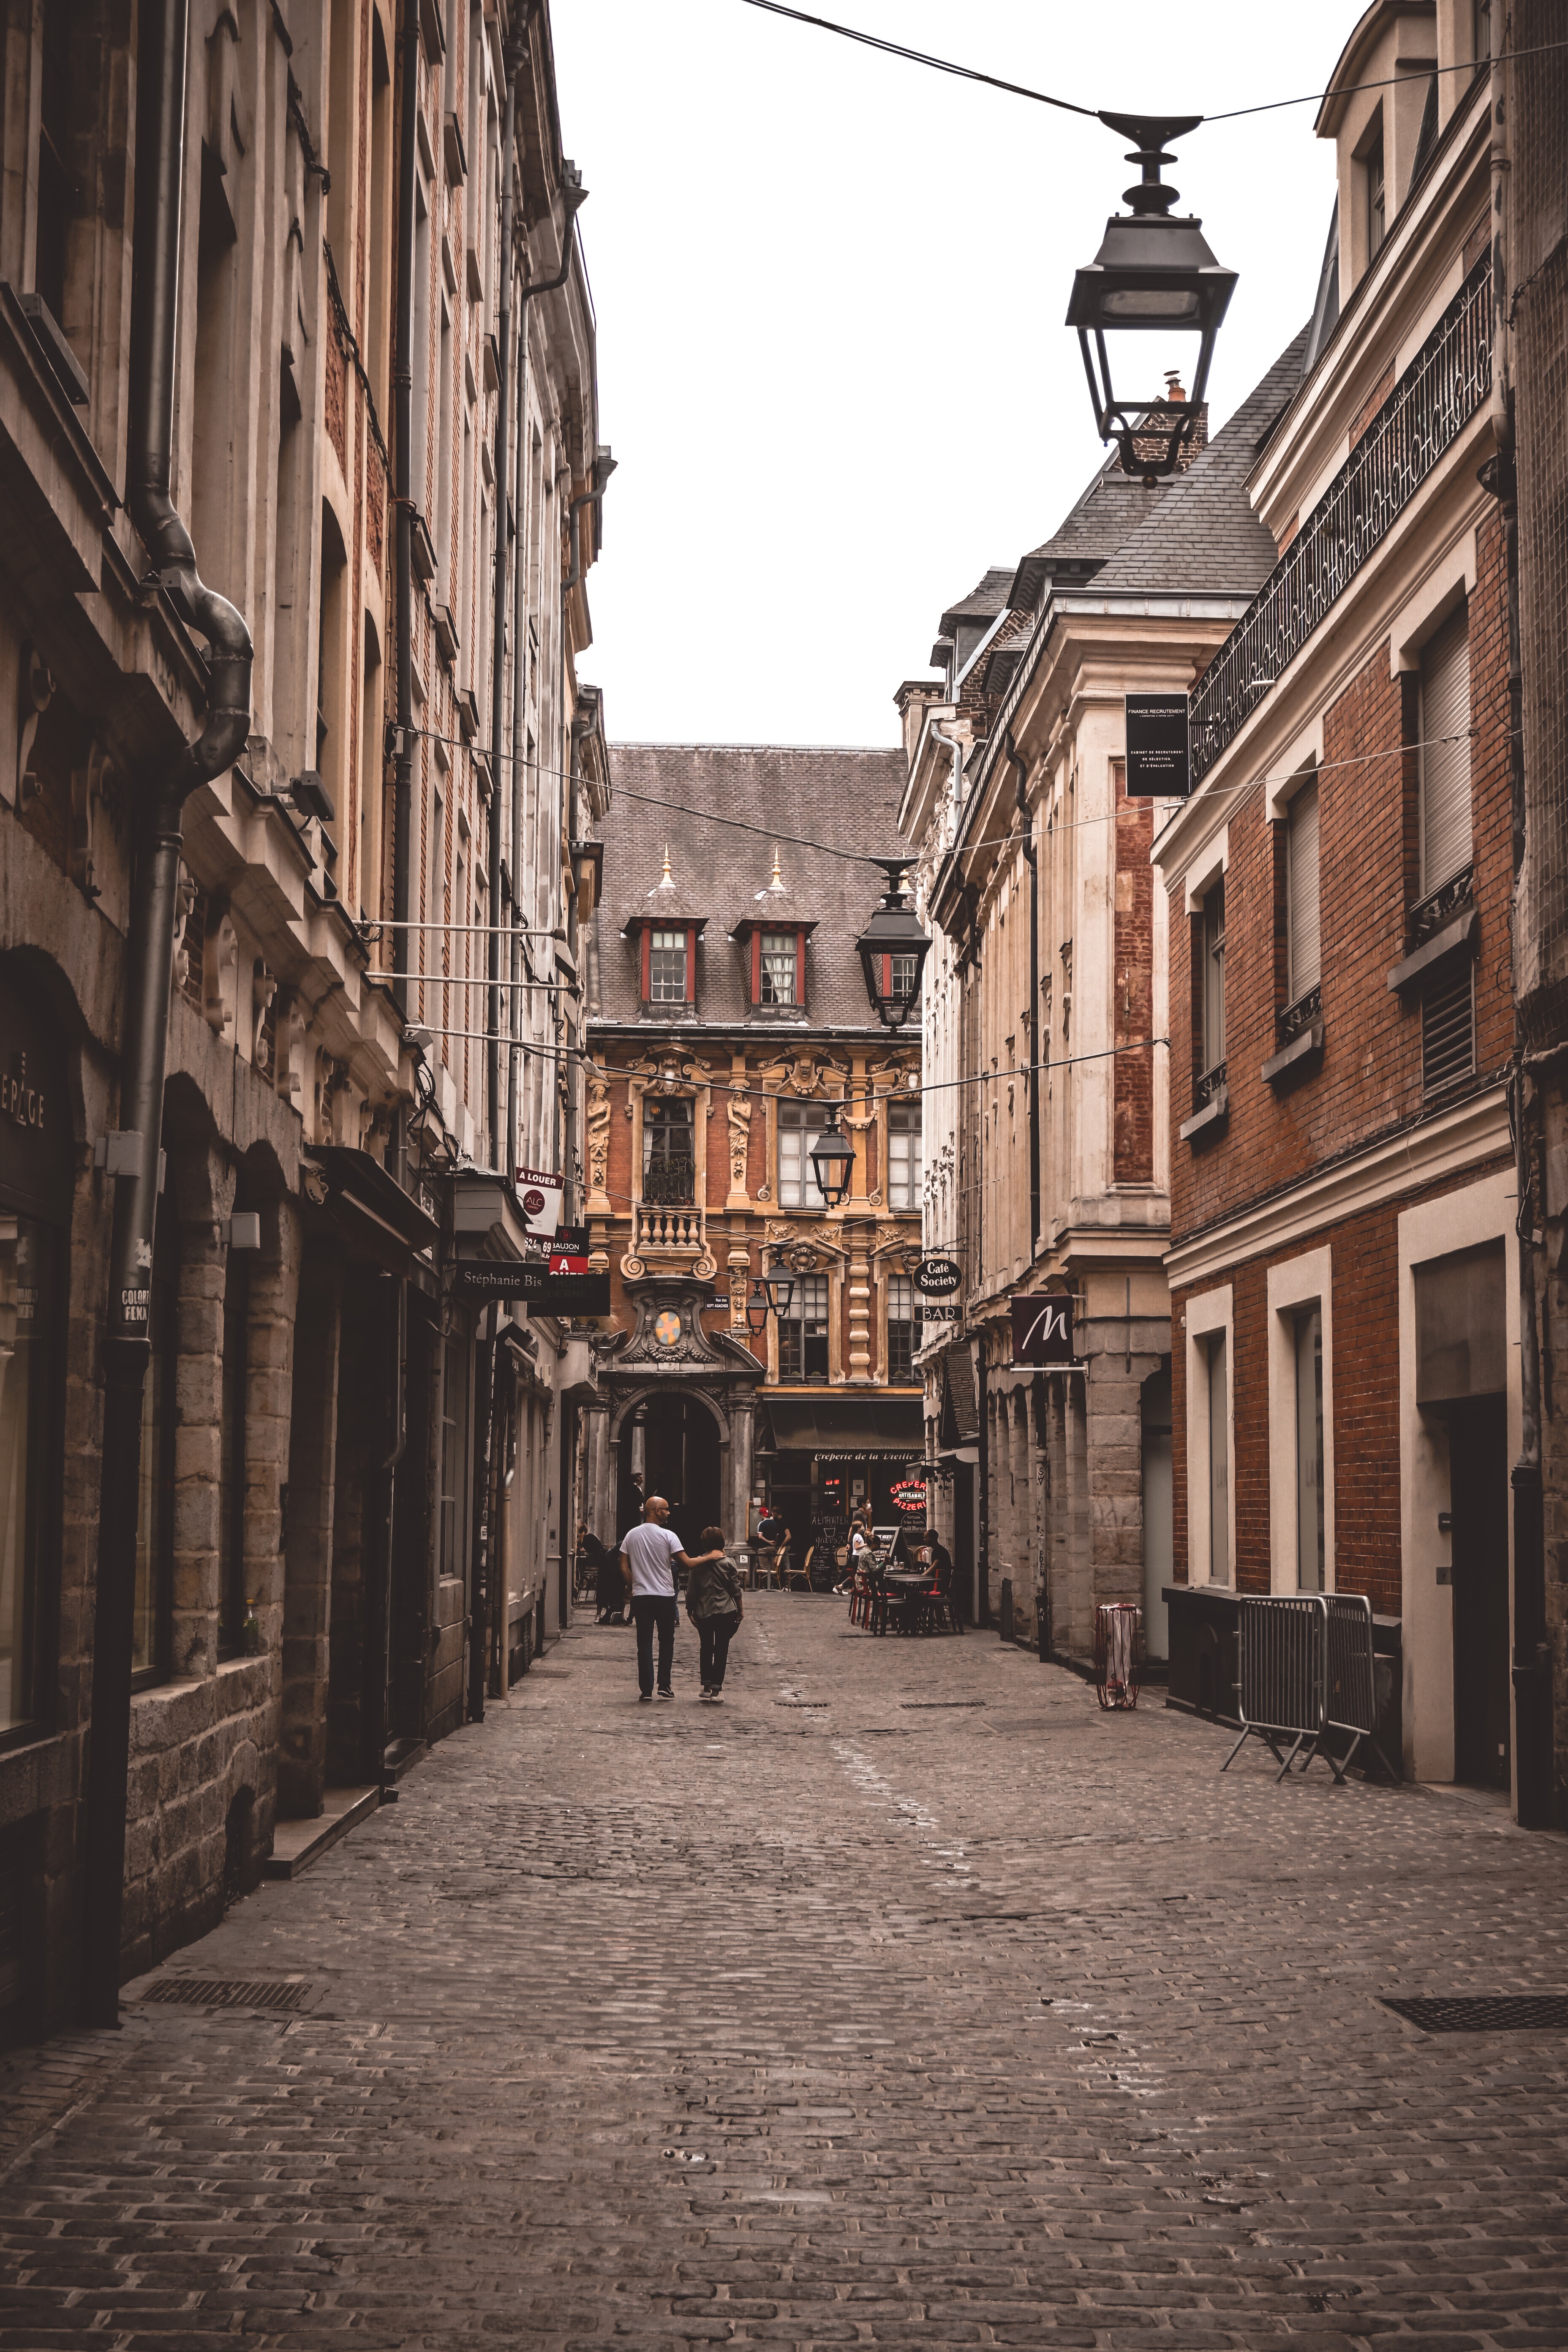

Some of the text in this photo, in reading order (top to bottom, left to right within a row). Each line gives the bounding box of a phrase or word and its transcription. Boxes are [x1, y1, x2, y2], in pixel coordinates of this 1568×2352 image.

[527, 1173, 556, 1186] LOUER
[526, 1197, 543, 1207] ALC
[543, 1241, 551, 1253] 69
[559, 1259, 569, 1270] A
[927, 1262, 949, 1274] Café
[464, 1271, 542, 1287] Stéphanie Bis
[920, 1274, 957, 1286] Society
[923, 1307, 955, 1320] BAR
[814, 1452, 852, 1462] Crêperie
[890, 1480, 927, 1494] CREPER
[893, 1497, 927, 1511] PIZZERI
